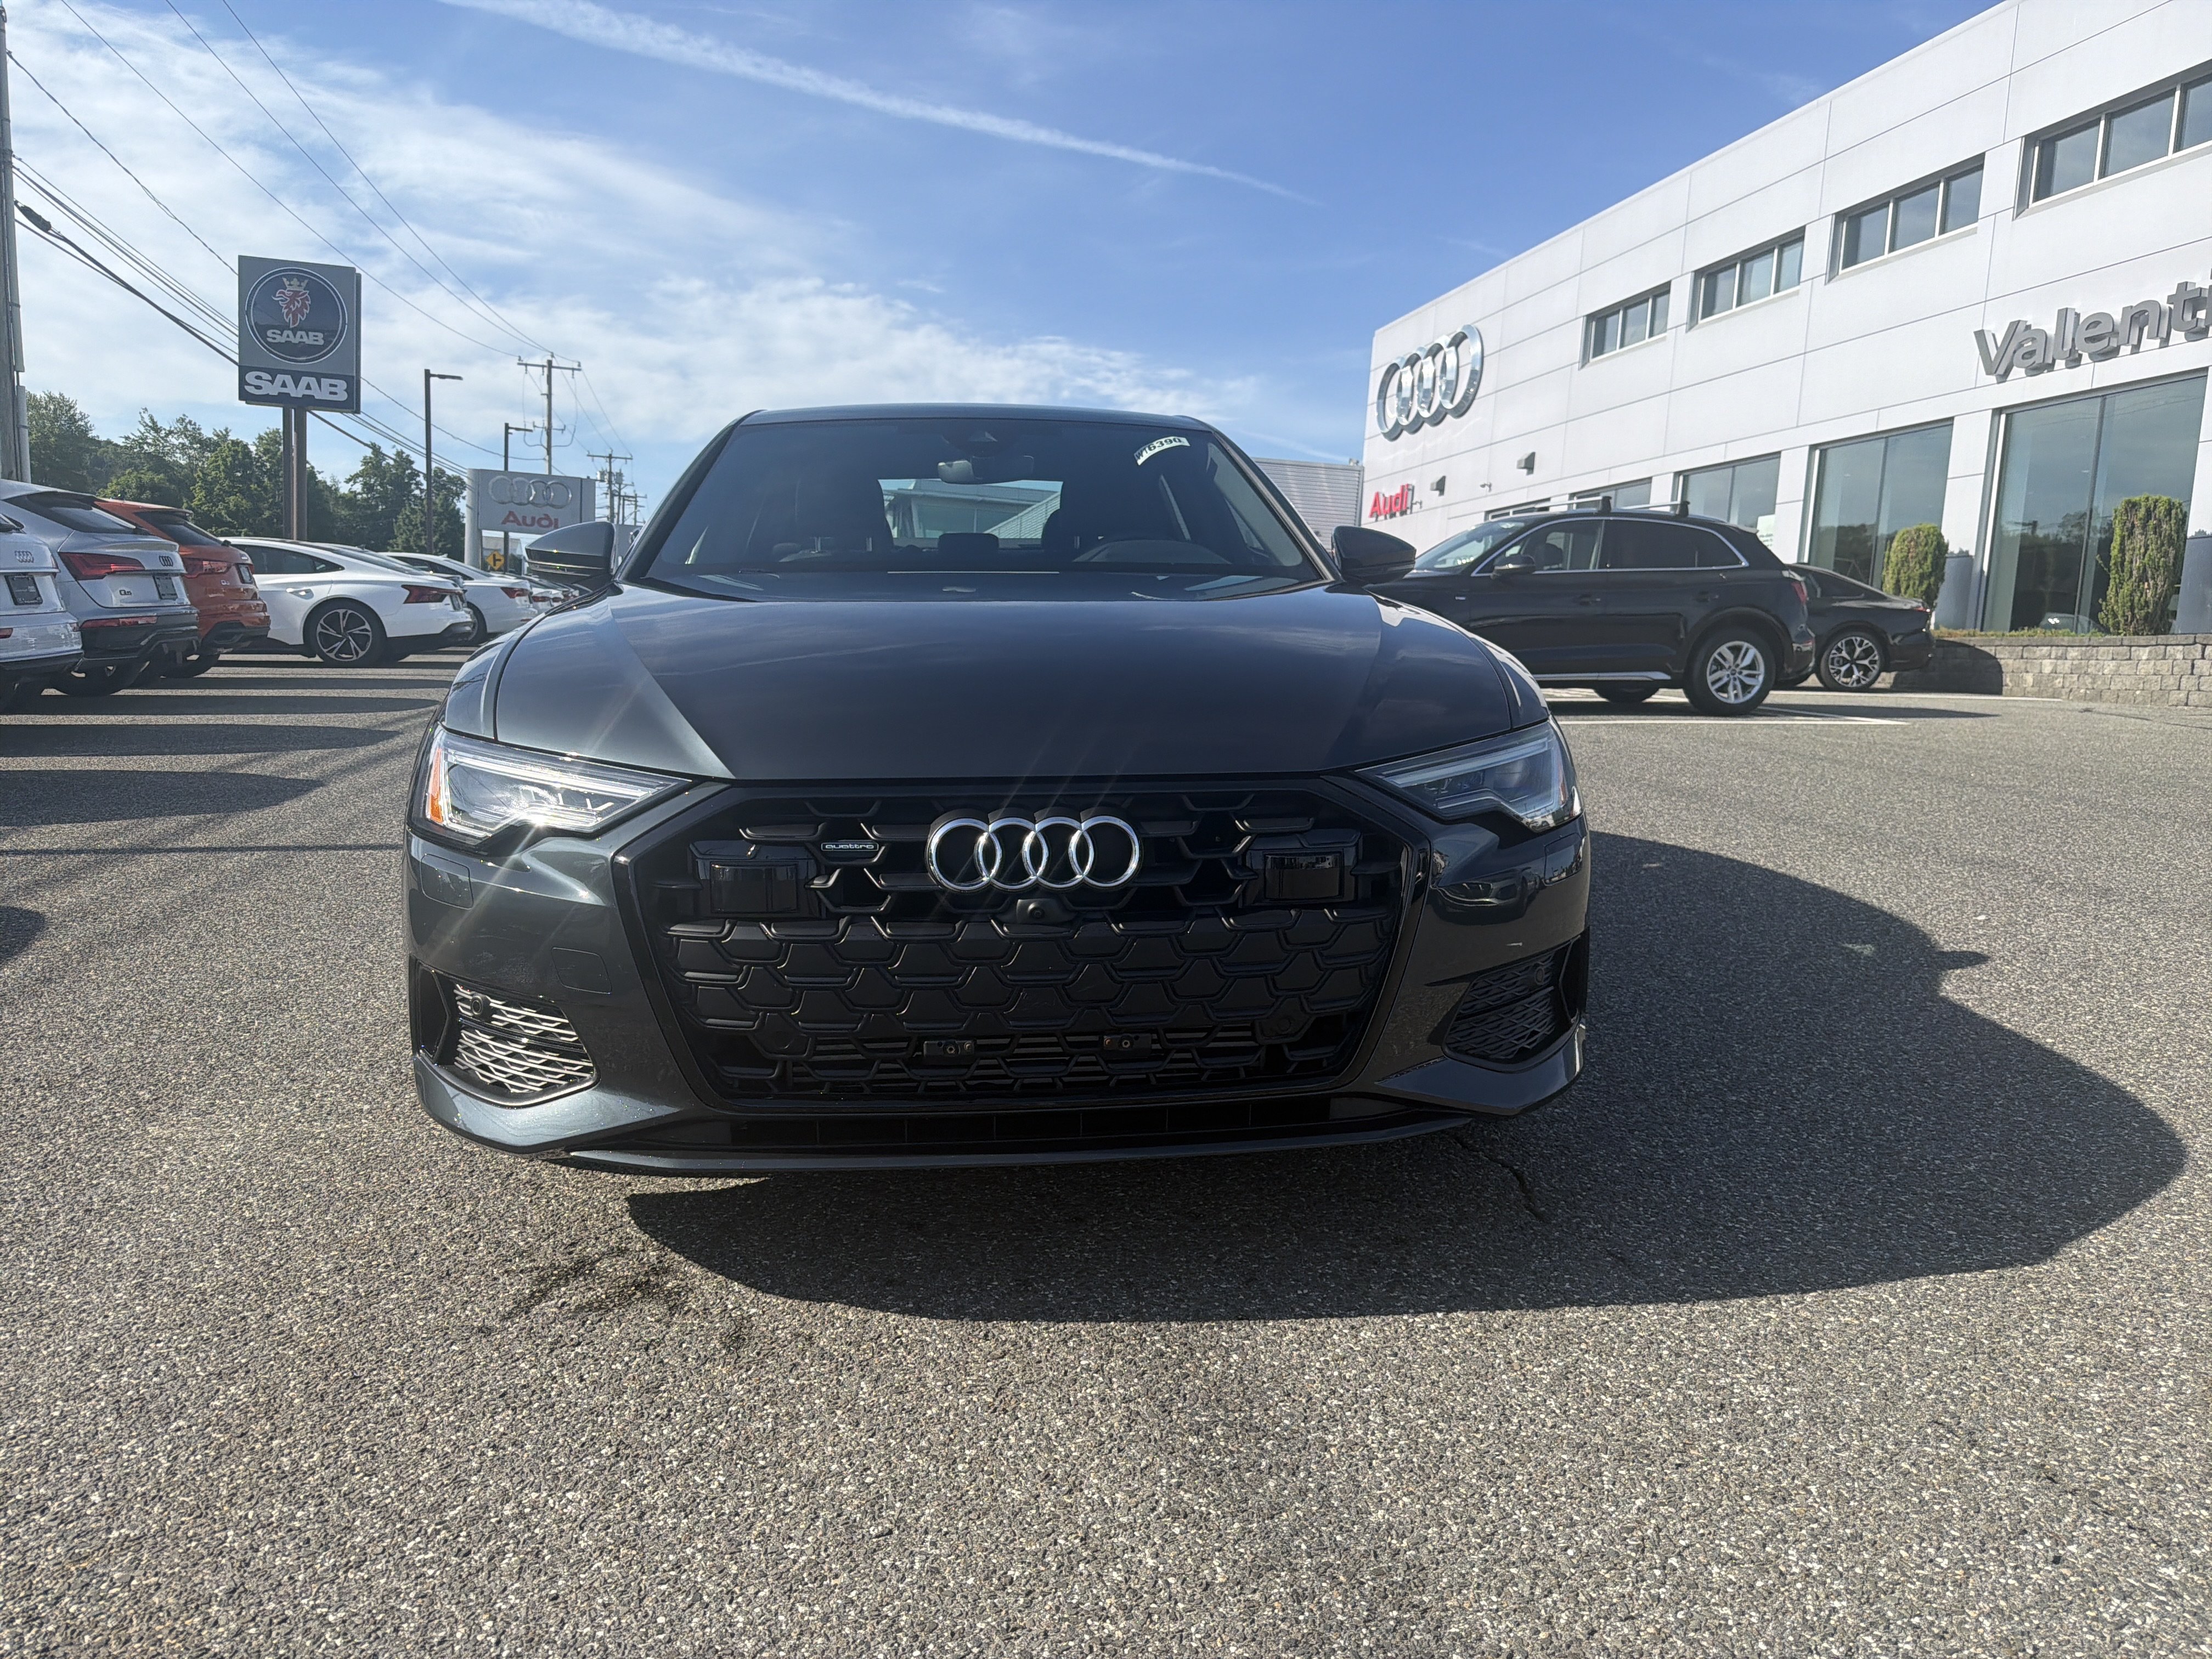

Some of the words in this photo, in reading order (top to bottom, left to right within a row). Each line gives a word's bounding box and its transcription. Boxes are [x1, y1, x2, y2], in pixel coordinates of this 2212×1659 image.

[267, 329, 324, 346] SAAB
[244, 371, 348, 401] SAAB
[1368, 483, 1409, 518] Audi
[501, 510, 559, 529] Audi
